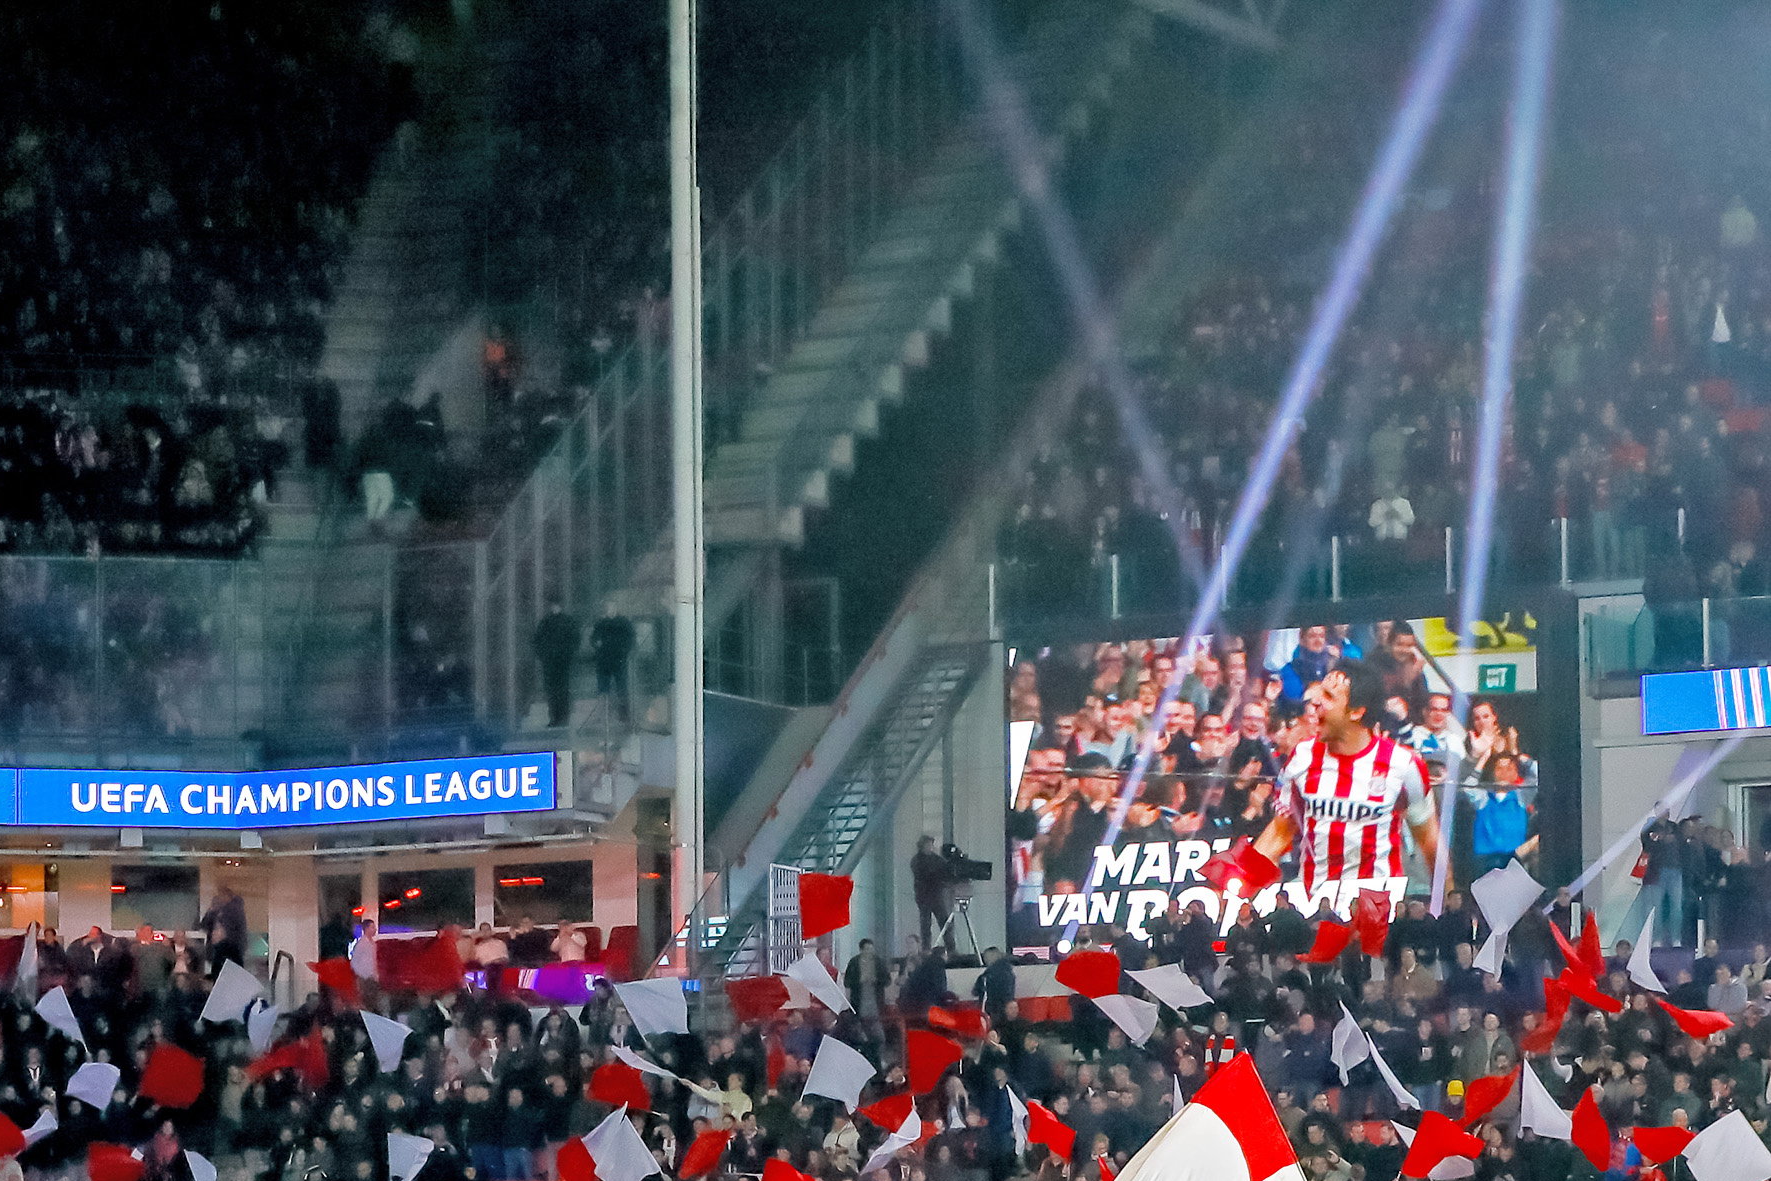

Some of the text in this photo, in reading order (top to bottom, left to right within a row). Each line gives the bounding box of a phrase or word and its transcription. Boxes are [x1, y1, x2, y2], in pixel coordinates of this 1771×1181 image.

[71, 765, 540, 815] UEFA CHAMPIONS LEAGUE
[1090, 837, 1232, 888] MAR
[1038, 890, 1120, 927] VAN
